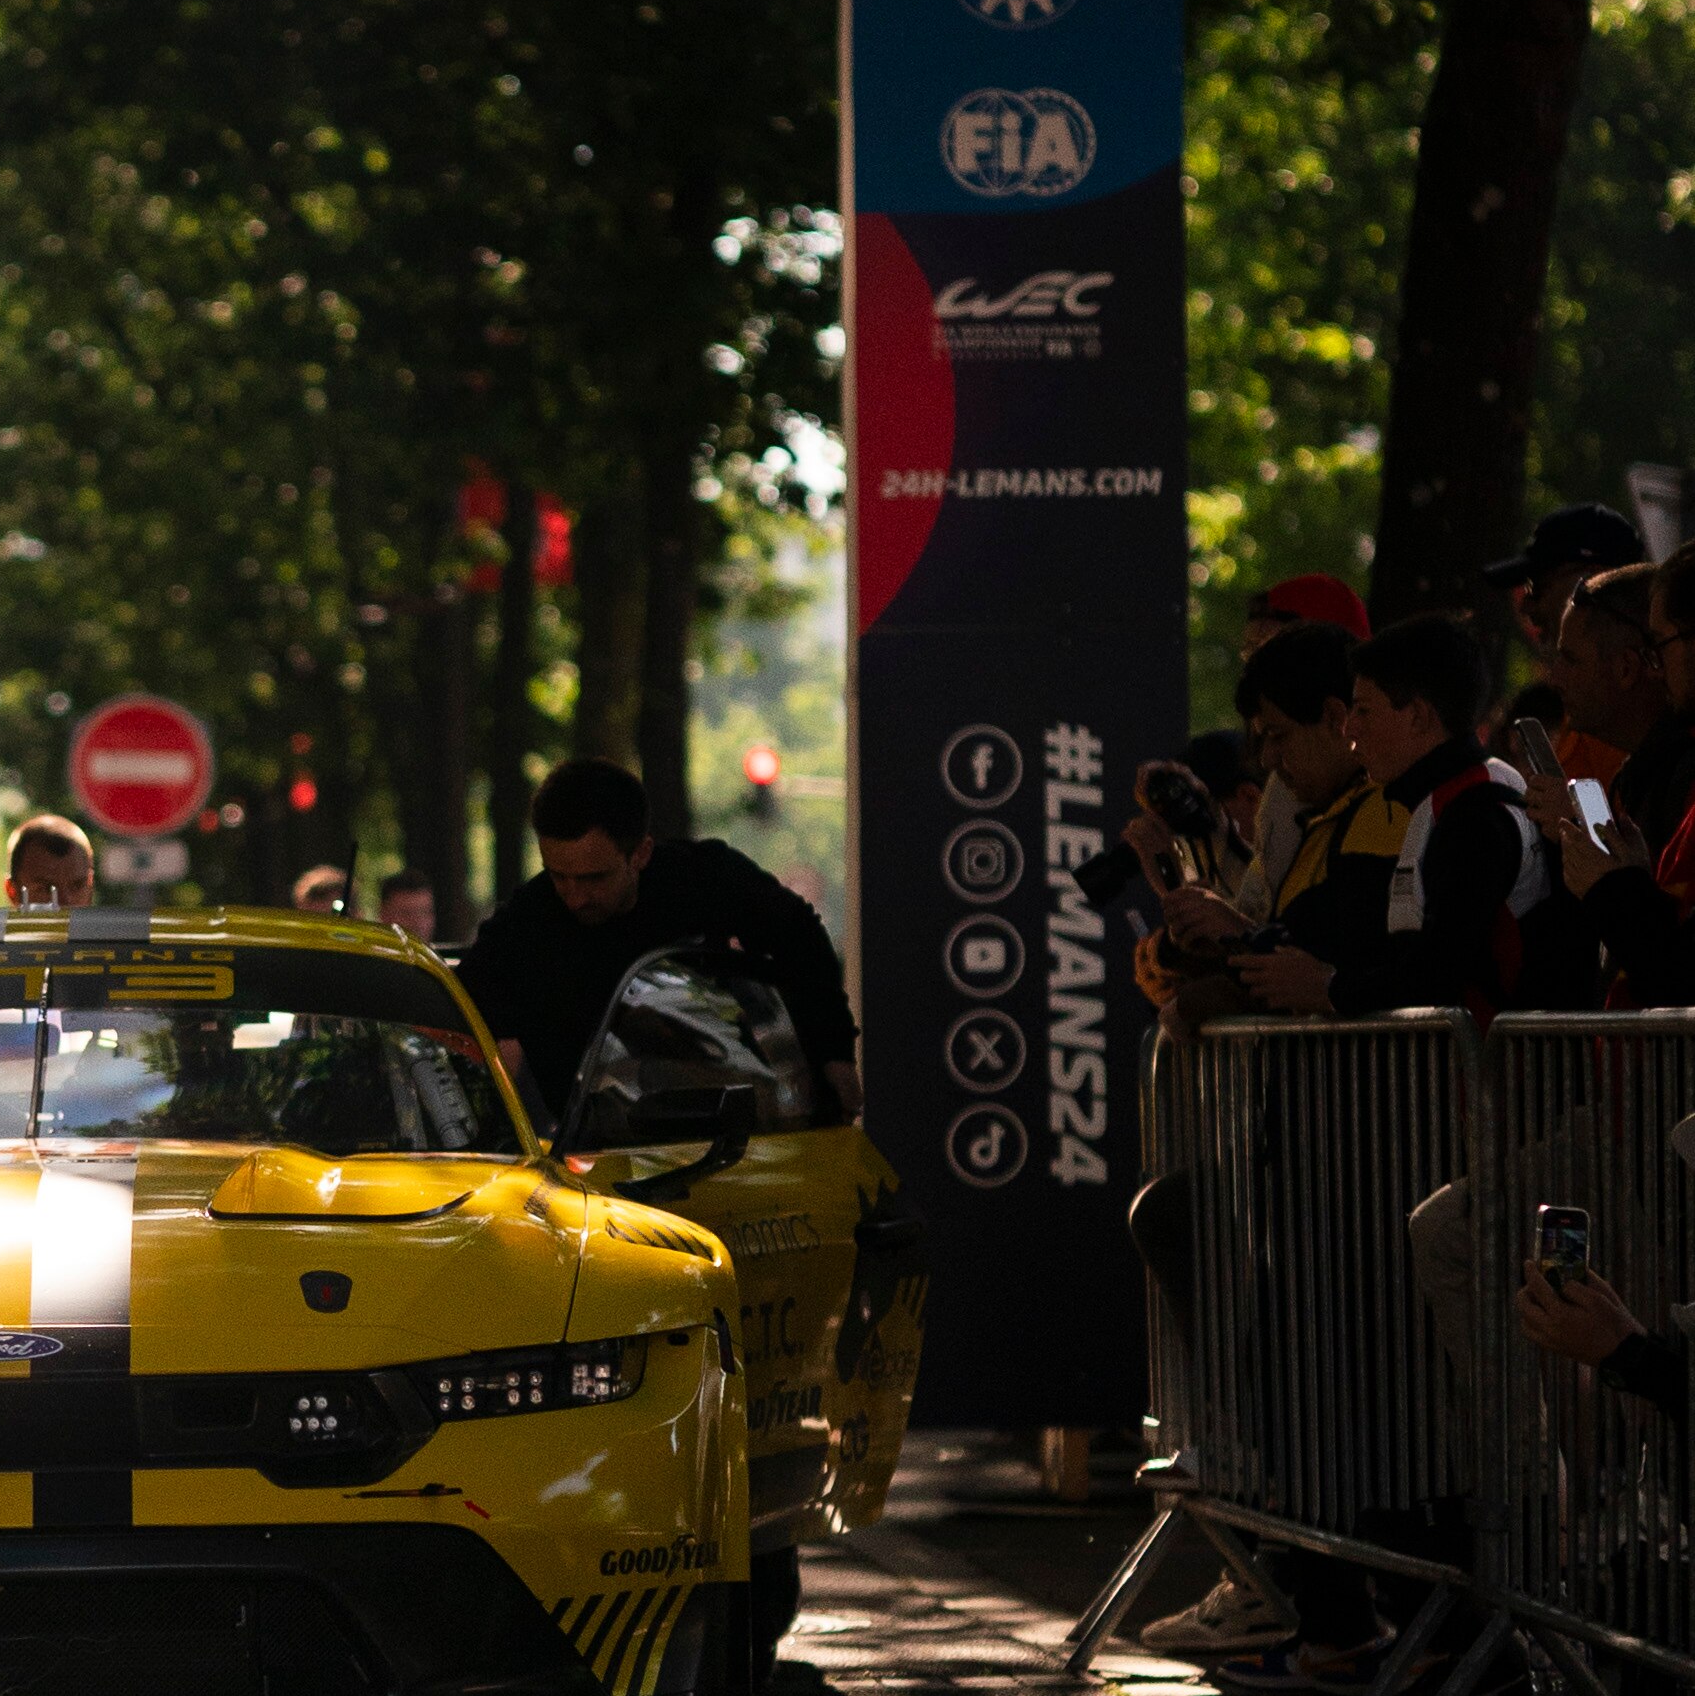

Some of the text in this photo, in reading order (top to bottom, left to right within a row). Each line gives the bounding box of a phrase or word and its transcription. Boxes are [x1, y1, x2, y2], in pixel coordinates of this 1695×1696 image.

[952, 109, 1082, 176] FIA
[933, 270, 1115, 320] WEC
[879, 467, 1164, 500] 24H-LEMANS.COM
